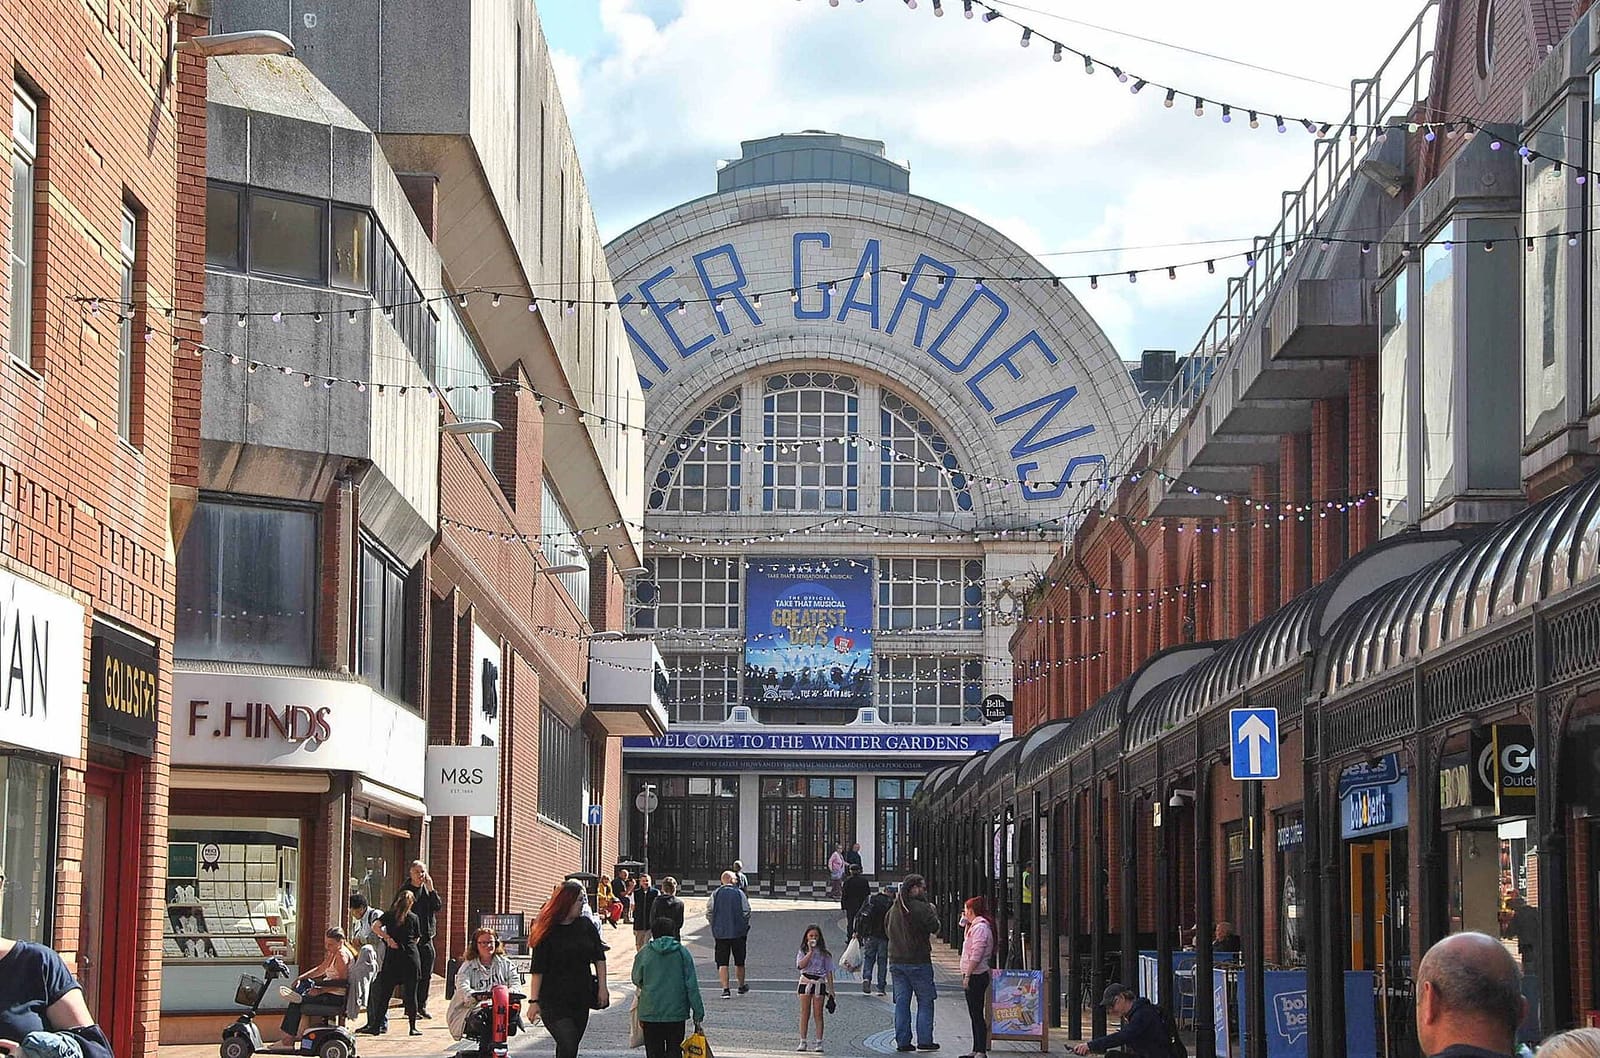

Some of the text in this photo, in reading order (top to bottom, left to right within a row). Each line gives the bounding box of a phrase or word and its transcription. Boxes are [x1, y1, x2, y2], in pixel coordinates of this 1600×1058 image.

[617, 231, 1107, 501] TER GARDENS
[775, 600, 846, 608] TAKE THAT MUSICAL
[771, 609, 846, 627] GREATEST
[789, 626, 829, 646] DAYS
[986, 699, 1005, 708] Bella
[986, 709, 1006, 717] Italia
[649, 734, 969, 750] WELCOME TO THE WINTER GARDENS
[441, 768, 483, 785] M&S
